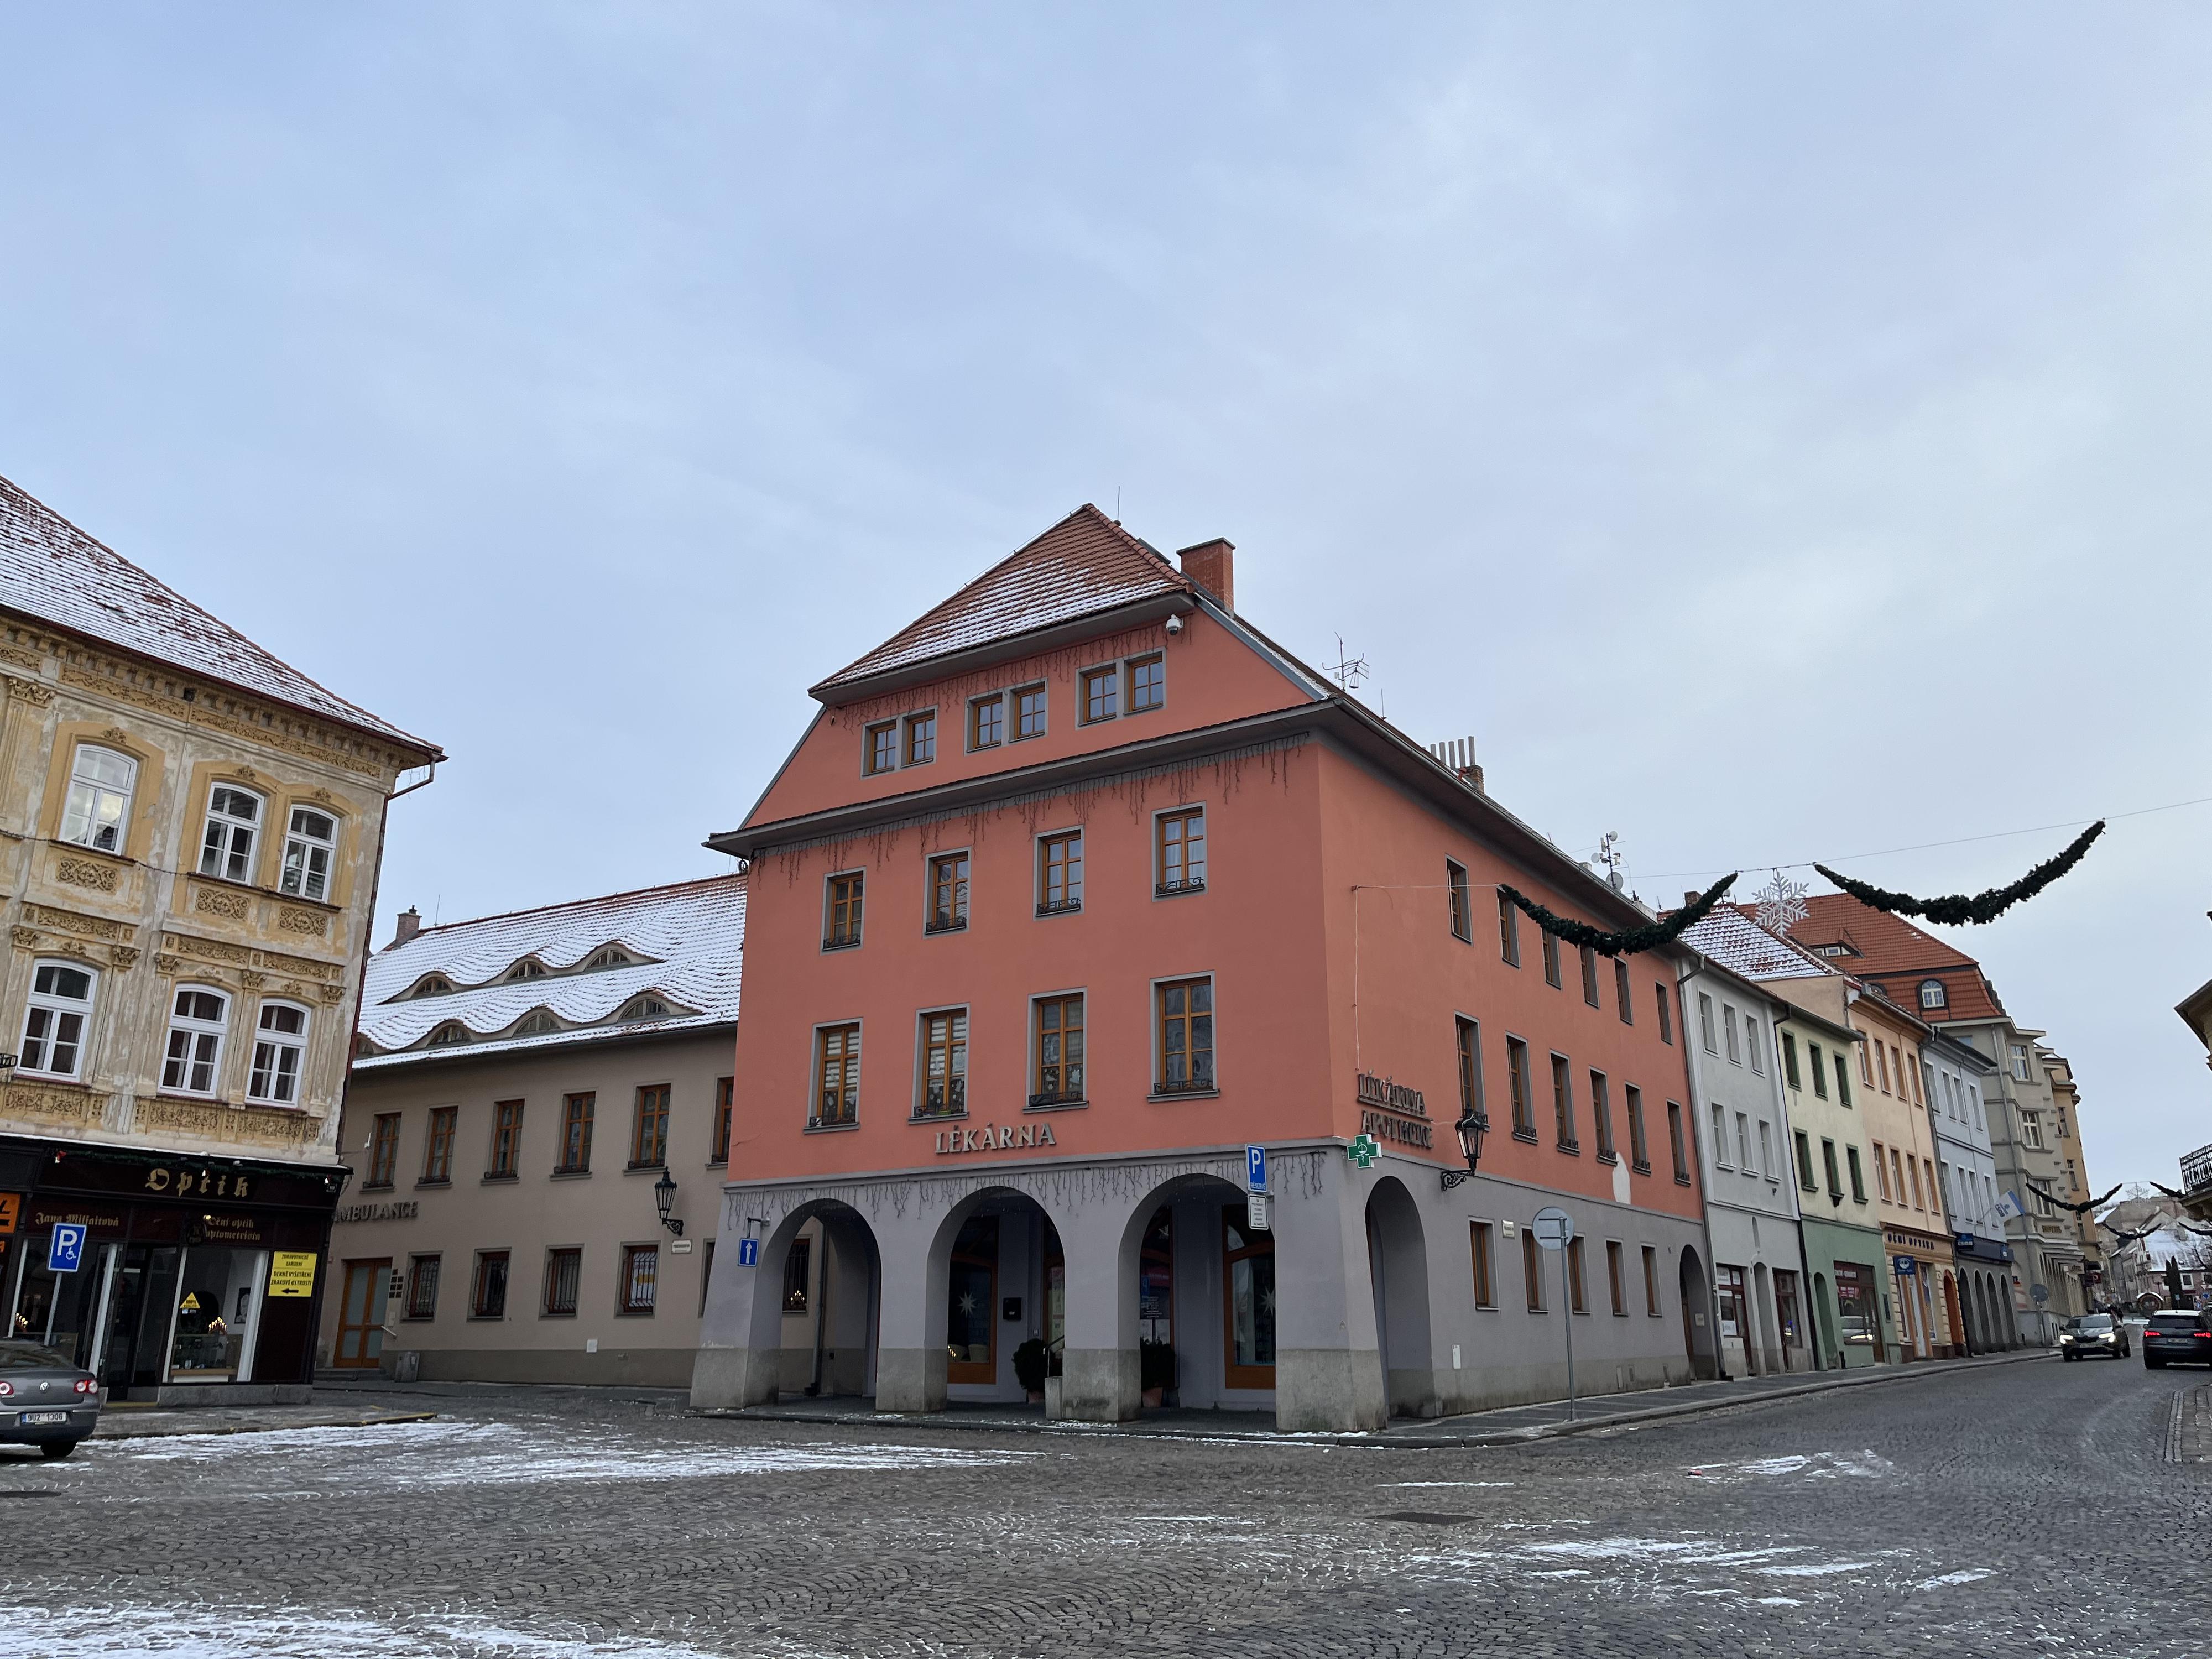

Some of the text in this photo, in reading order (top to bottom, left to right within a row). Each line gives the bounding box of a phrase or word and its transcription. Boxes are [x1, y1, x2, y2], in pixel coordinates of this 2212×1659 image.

[935, 1121, 1057, 1154] LÉKÁRNA
[1251, 1149, 1261, 1174] P
[145, 1168, 248, 1198] Optik
[57, 1229, 78, 1256] P
[28, 1413, 41, 1422] 9U2
